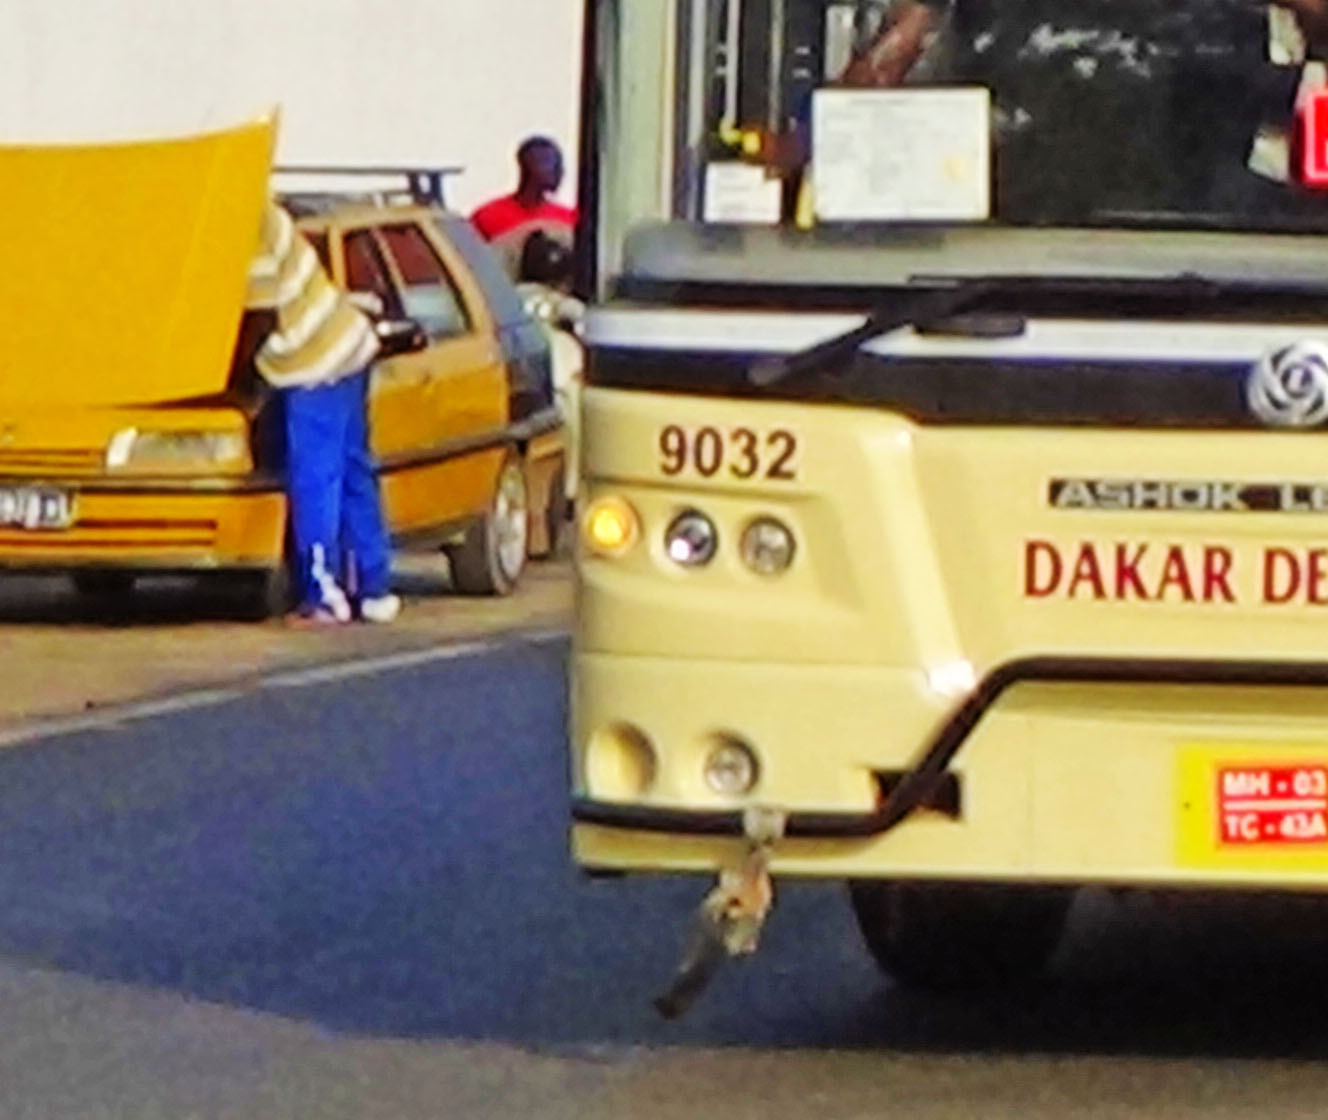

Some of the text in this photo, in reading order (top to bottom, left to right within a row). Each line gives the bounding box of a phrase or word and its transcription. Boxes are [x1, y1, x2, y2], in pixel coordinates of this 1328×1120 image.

[659, 425, 797, 480] 9032
[1056, 482, 1246, 510] ASHOK
[1023, 539, 1238, 603] DAKAR
[1223, 771, 1270, 795] MH
[1293, 770, 1327, 796] 03
[1224, 812, 1259, 840] TC
